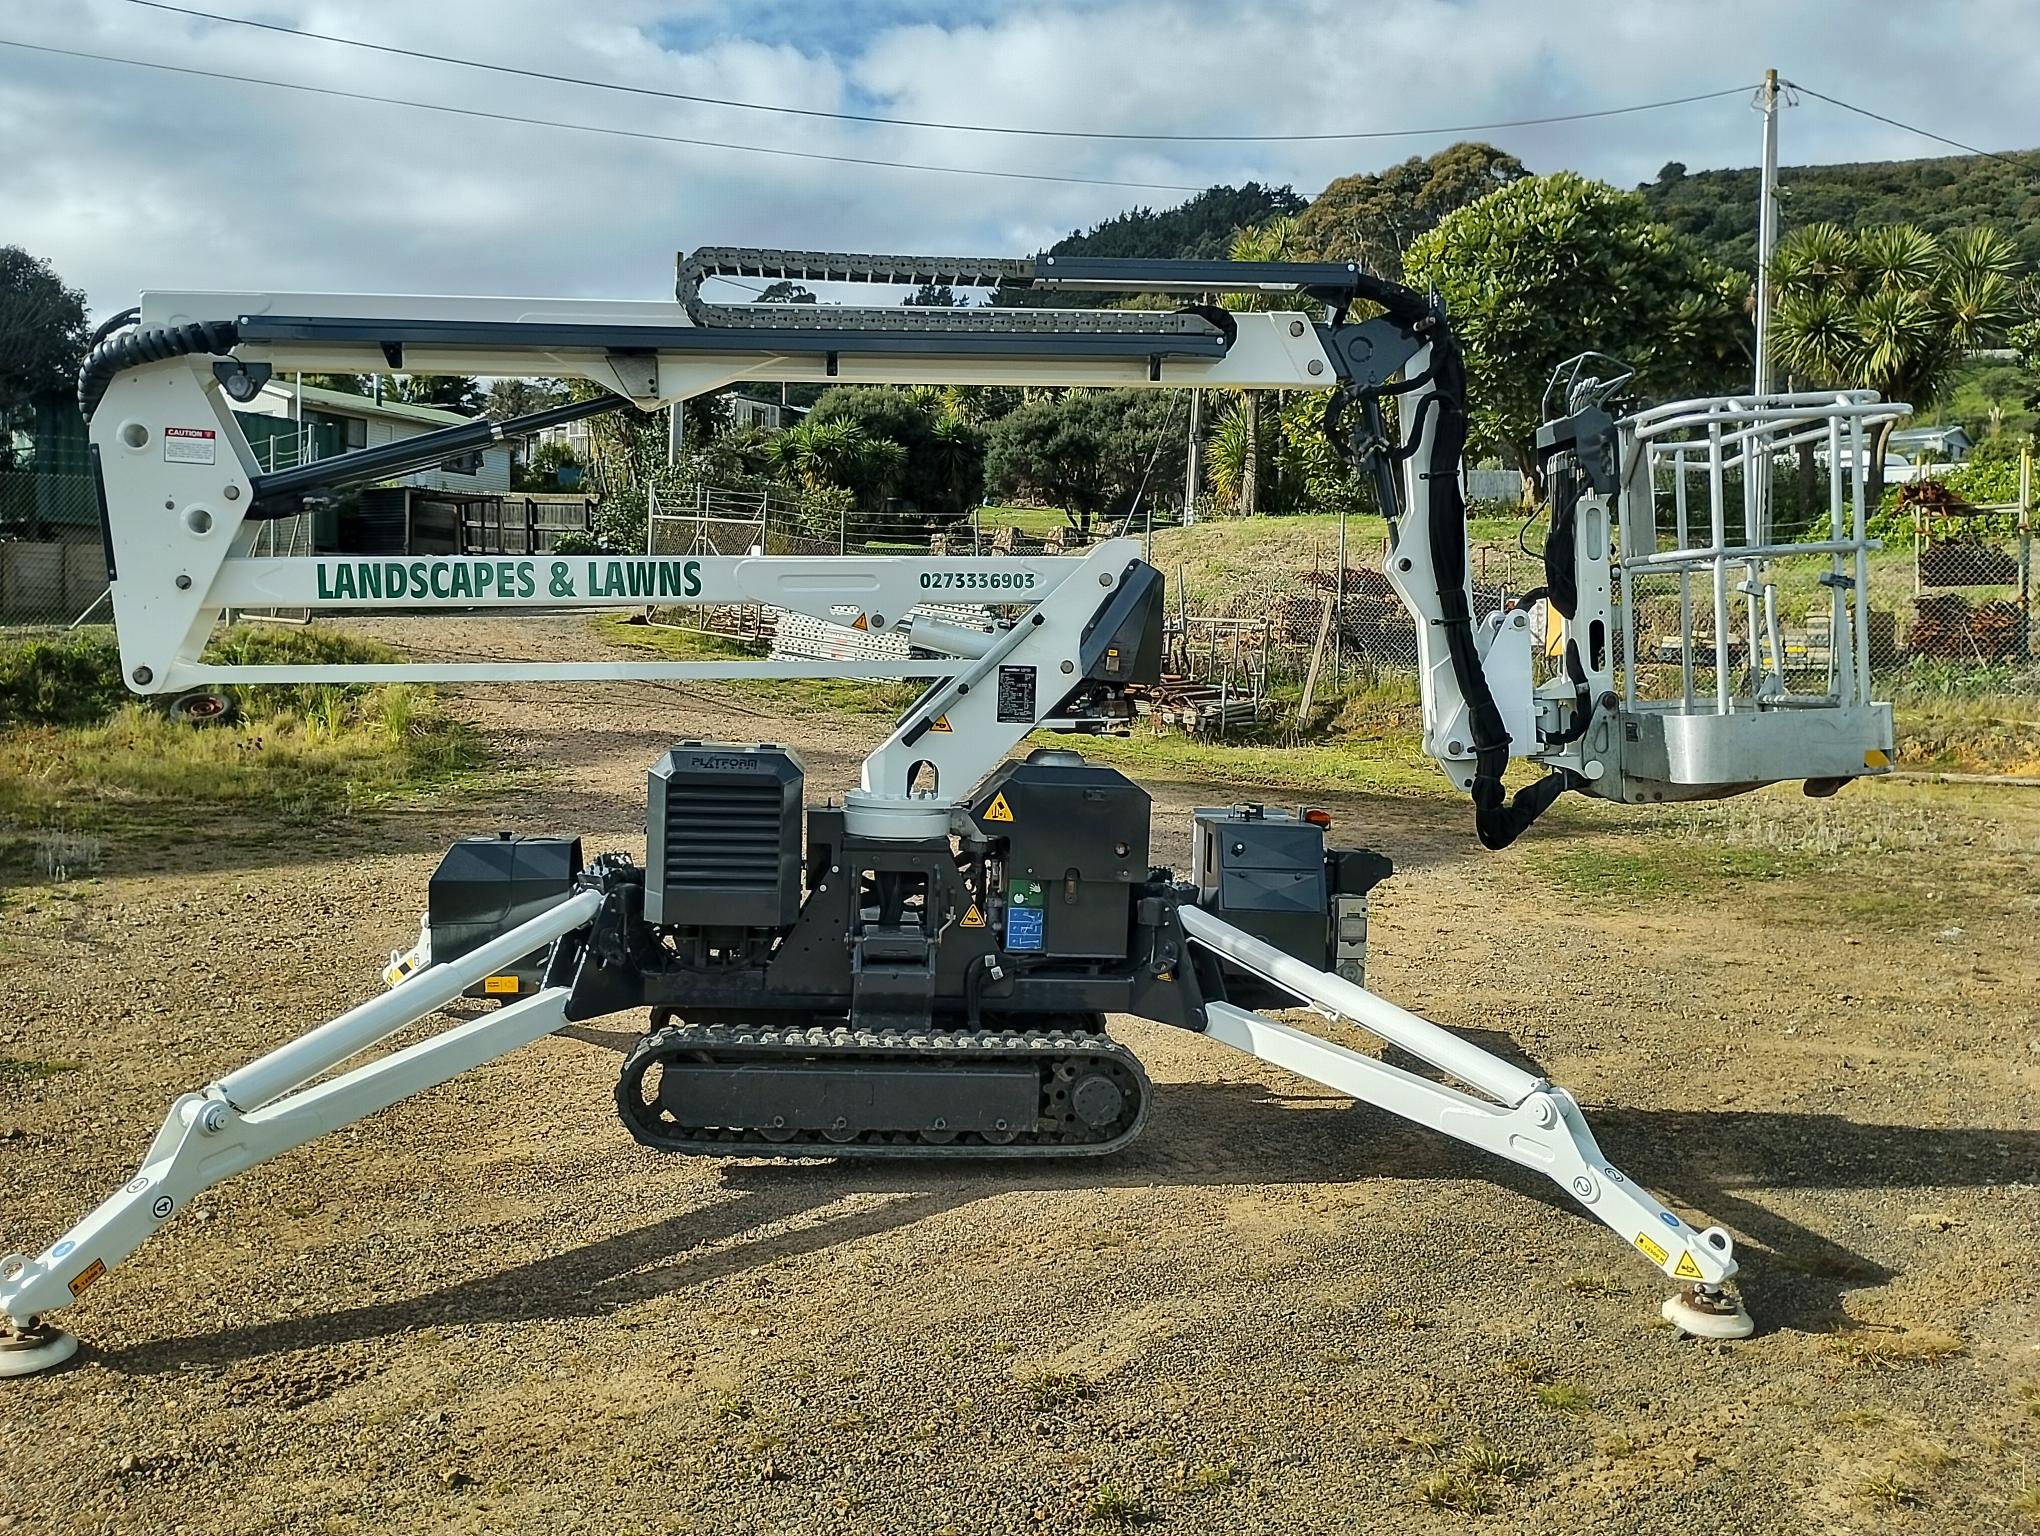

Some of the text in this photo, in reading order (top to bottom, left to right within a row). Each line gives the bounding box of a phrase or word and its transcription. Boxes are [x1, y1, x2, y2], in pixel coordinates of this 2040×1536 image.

[168, 429, 203, 437] CAUTION
[316, 561, 702, 599] LANDSCAPES & LAWNS
[919, 572, 1035, 589] 0273336903
[691, 755, 758, 770] PLATFORM
